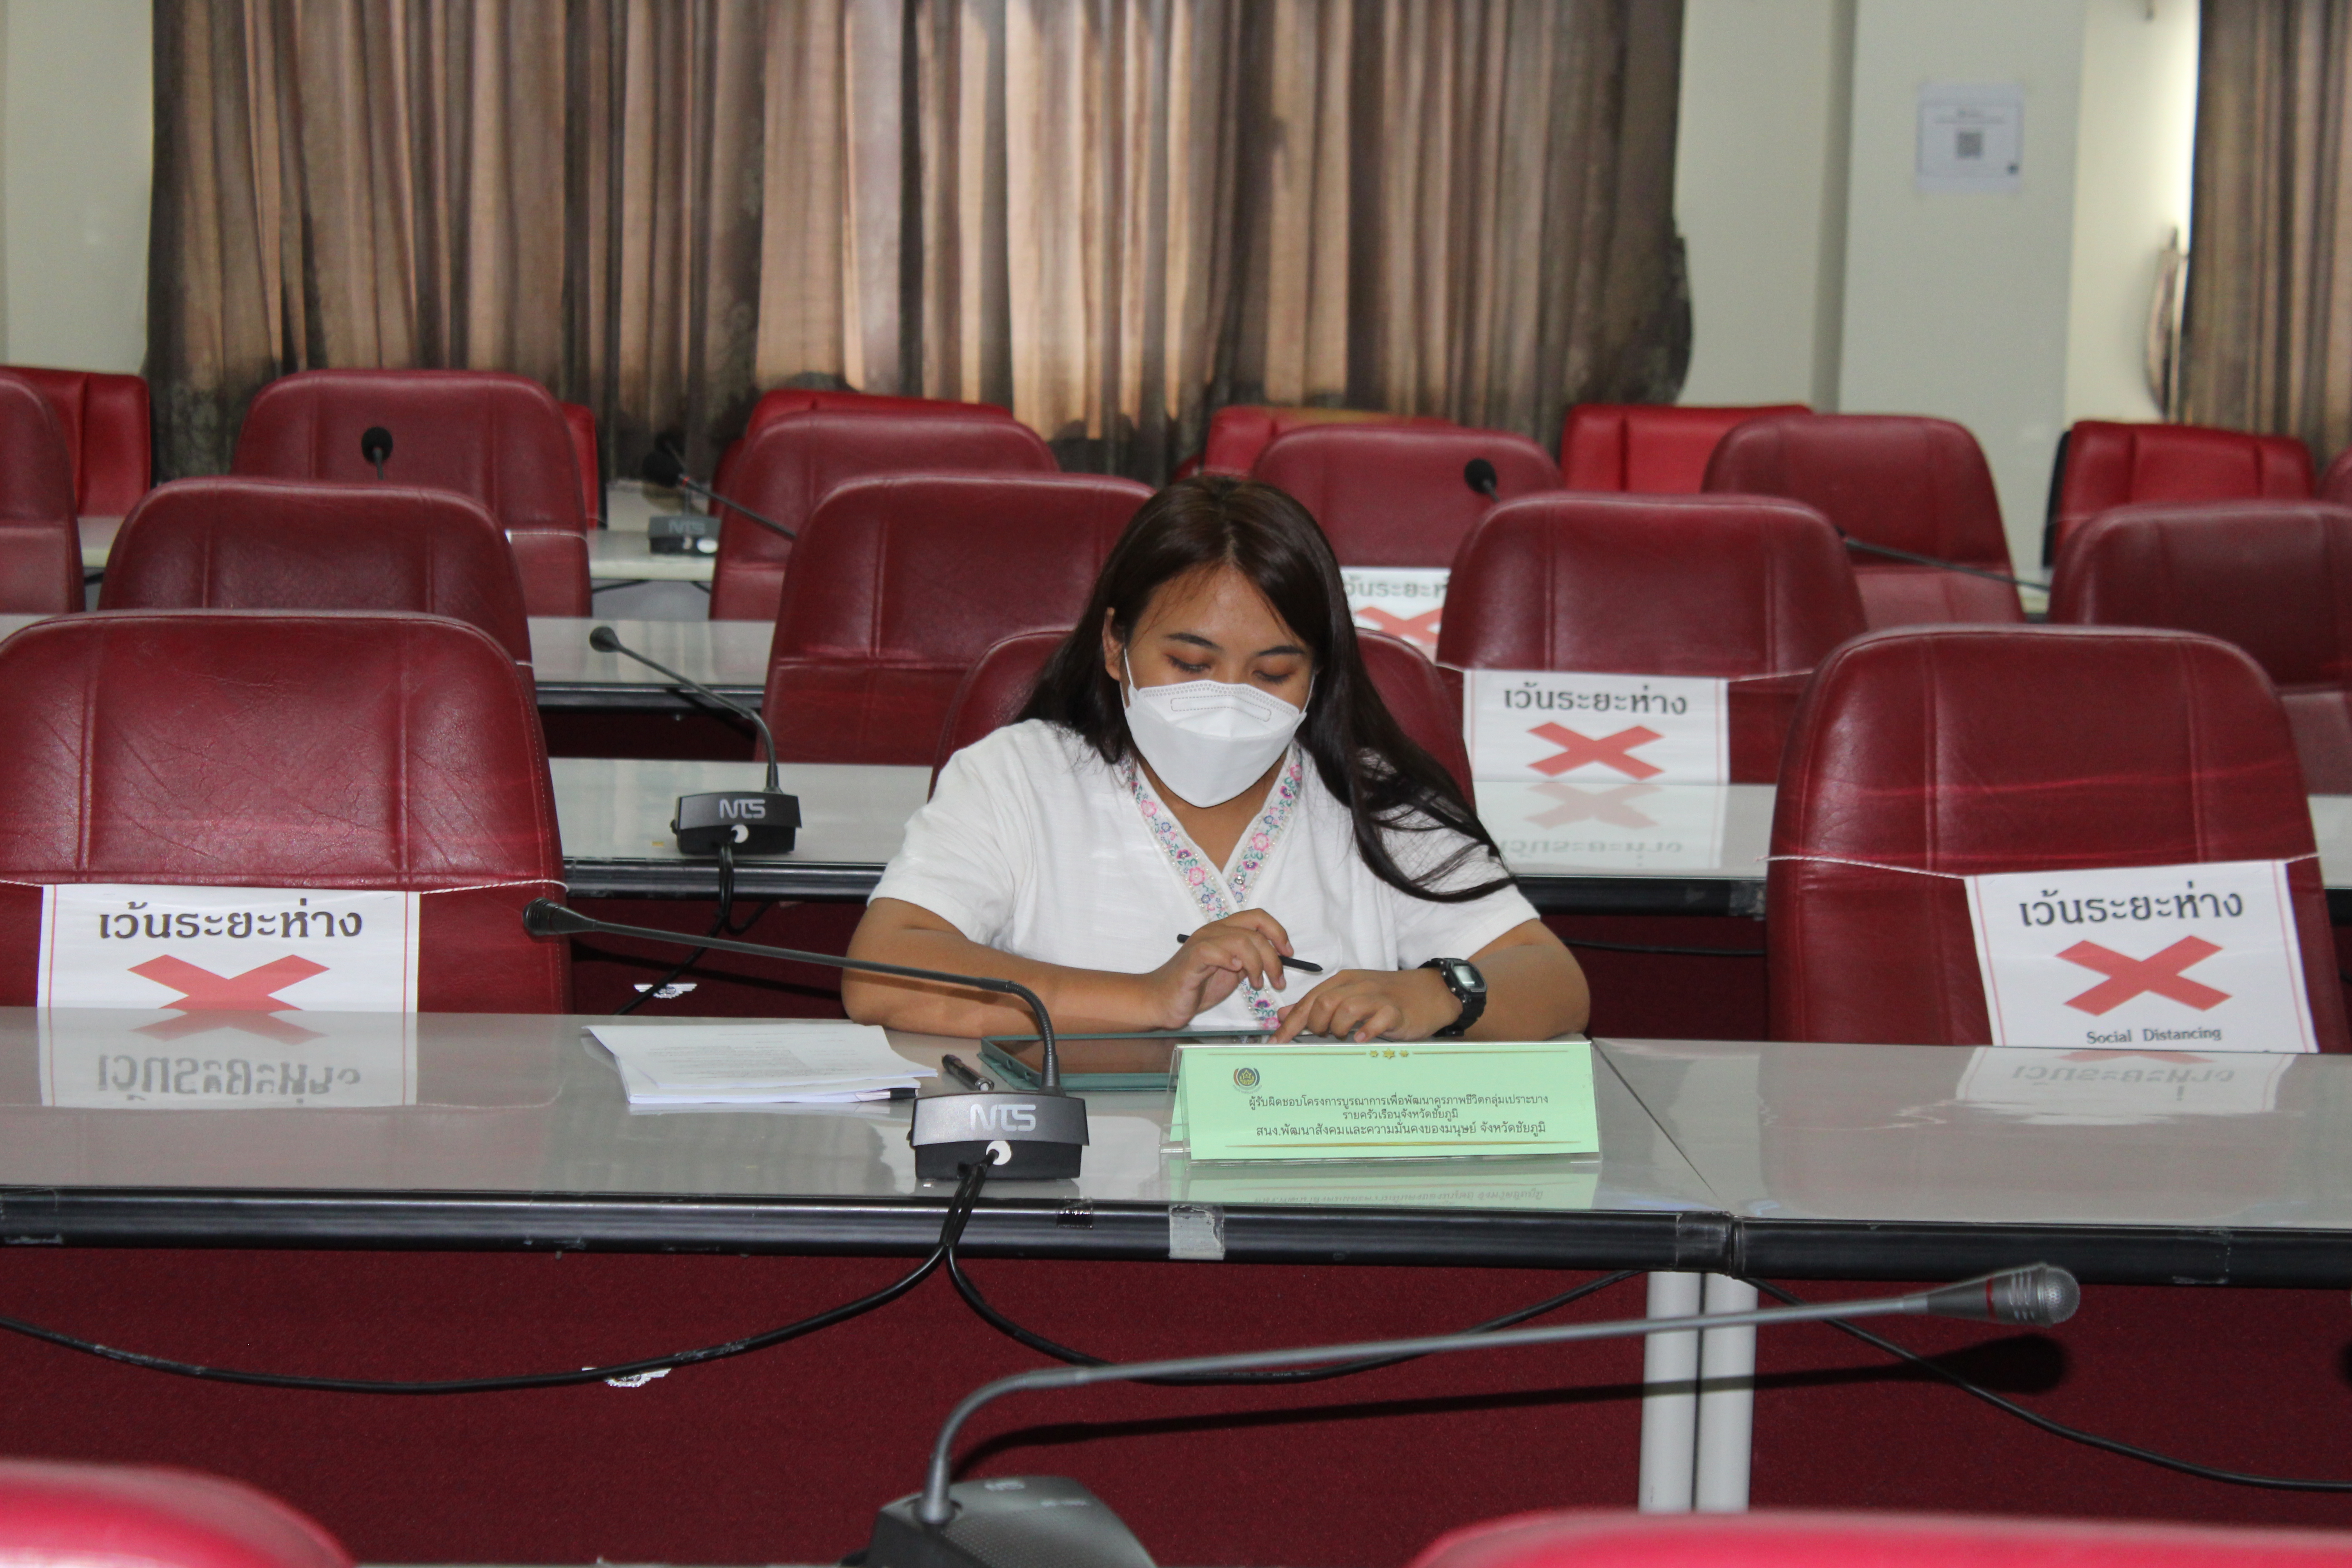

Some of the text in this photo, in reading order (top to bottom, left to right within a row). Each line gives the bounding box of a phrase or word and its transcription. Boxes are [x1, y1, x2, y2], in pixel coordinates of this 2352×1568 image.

[1504, 681, 1687, 715] เว้นระยะห่าง
[719, 799, 766, 819] NTS
[2019, 880, 2243, 927] เว้นระยะห่าง
[99, 897, 363, 940] เว้นระยะห่าง
[2086, 1026, 2222, 1044] Social Distancing
[970, 1103, 1036, 1132] NTS
[1480, 1120, 1546, 1137] จังหวัดชัยภูมิ
